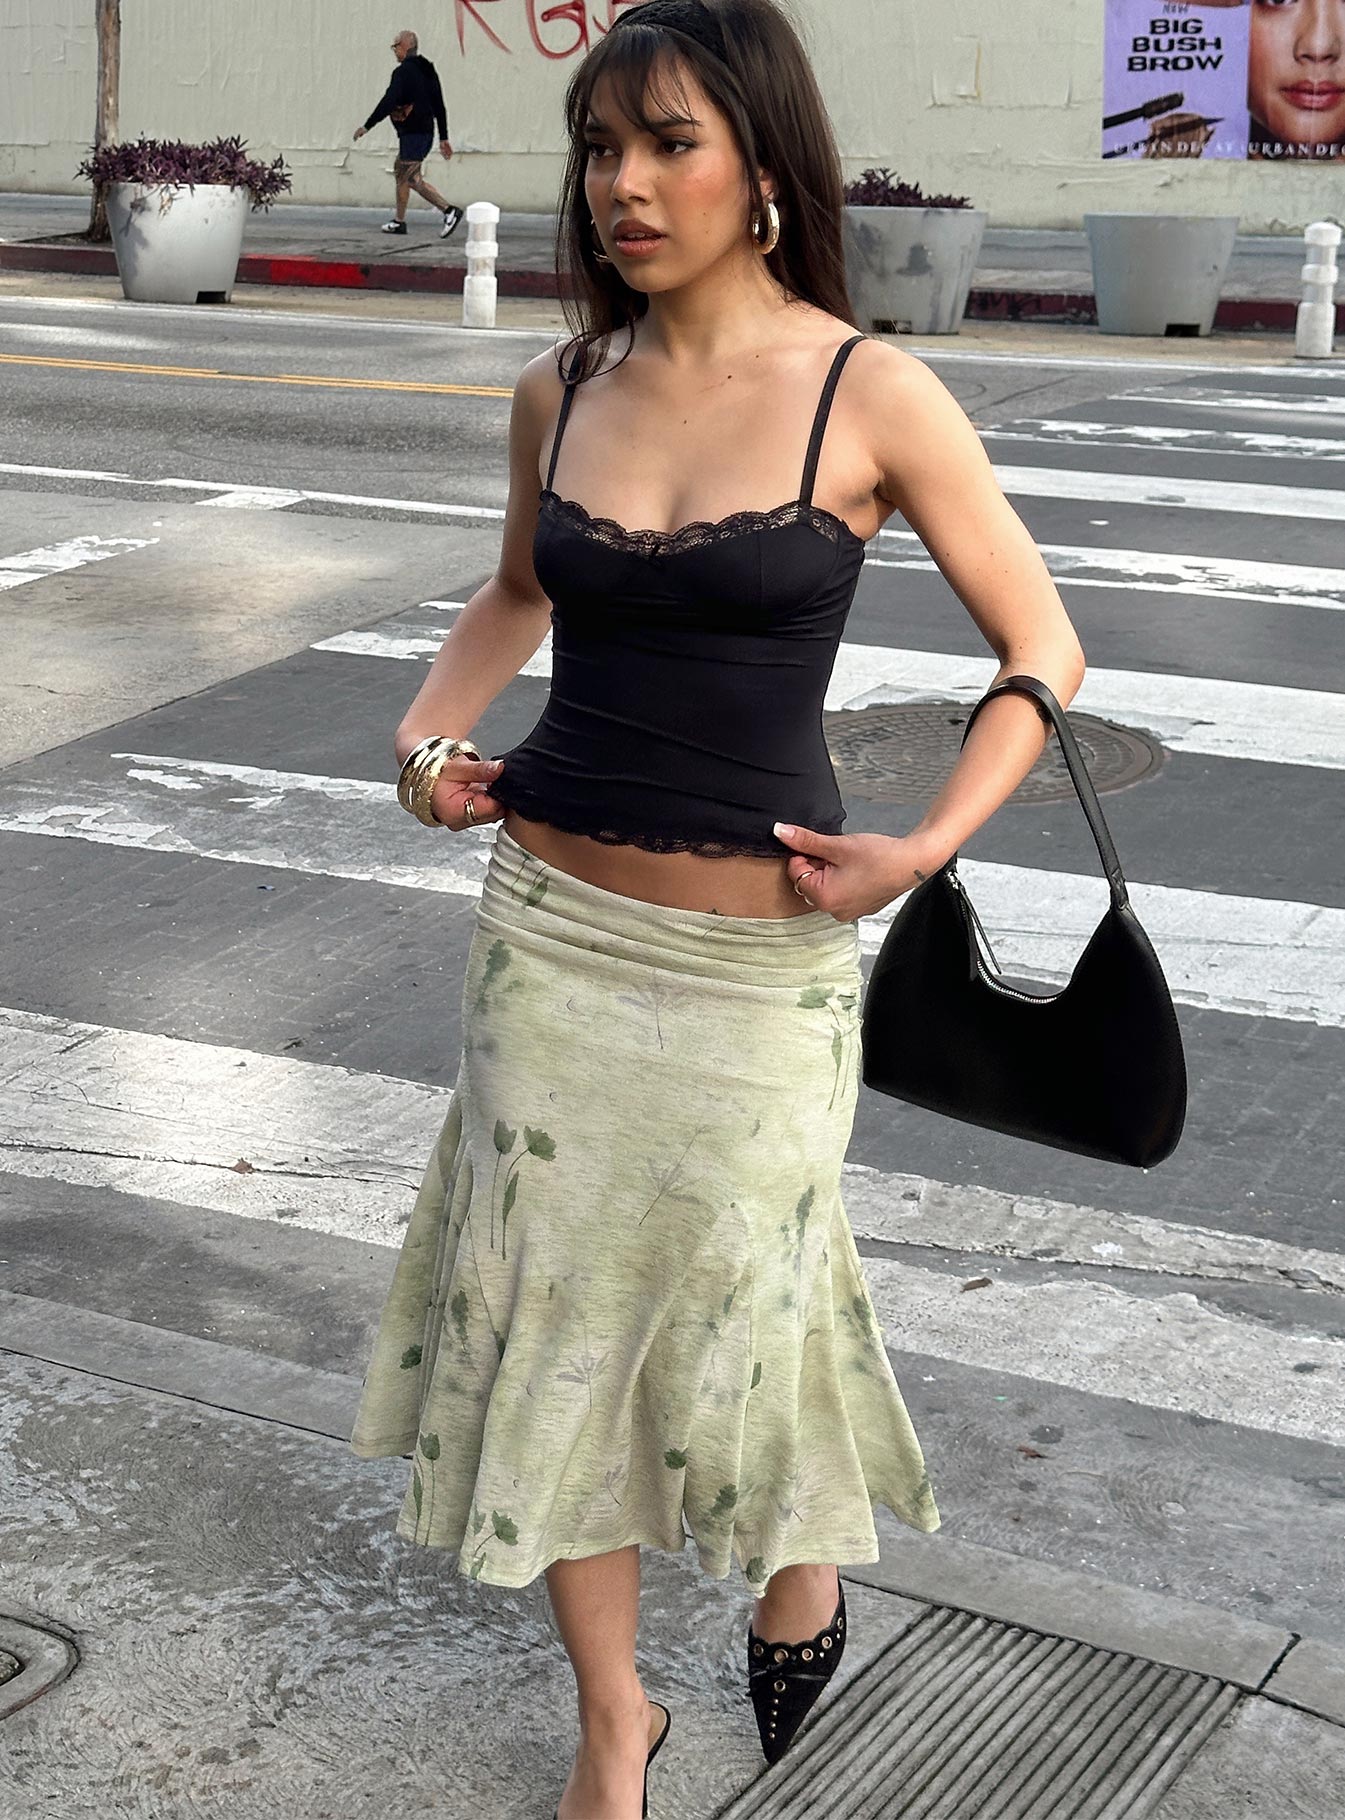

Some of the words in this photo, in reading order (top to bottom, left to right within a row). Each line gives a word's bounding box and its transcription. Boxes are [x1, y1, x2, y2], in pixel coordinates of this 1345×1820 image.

[1150, 18, 1203, 34] BIG
[1132, 37, 1222, 52] BUSH
[1127, 55, 1224, 71] BROW
[1248, 142, 1309, 158] URBAN
